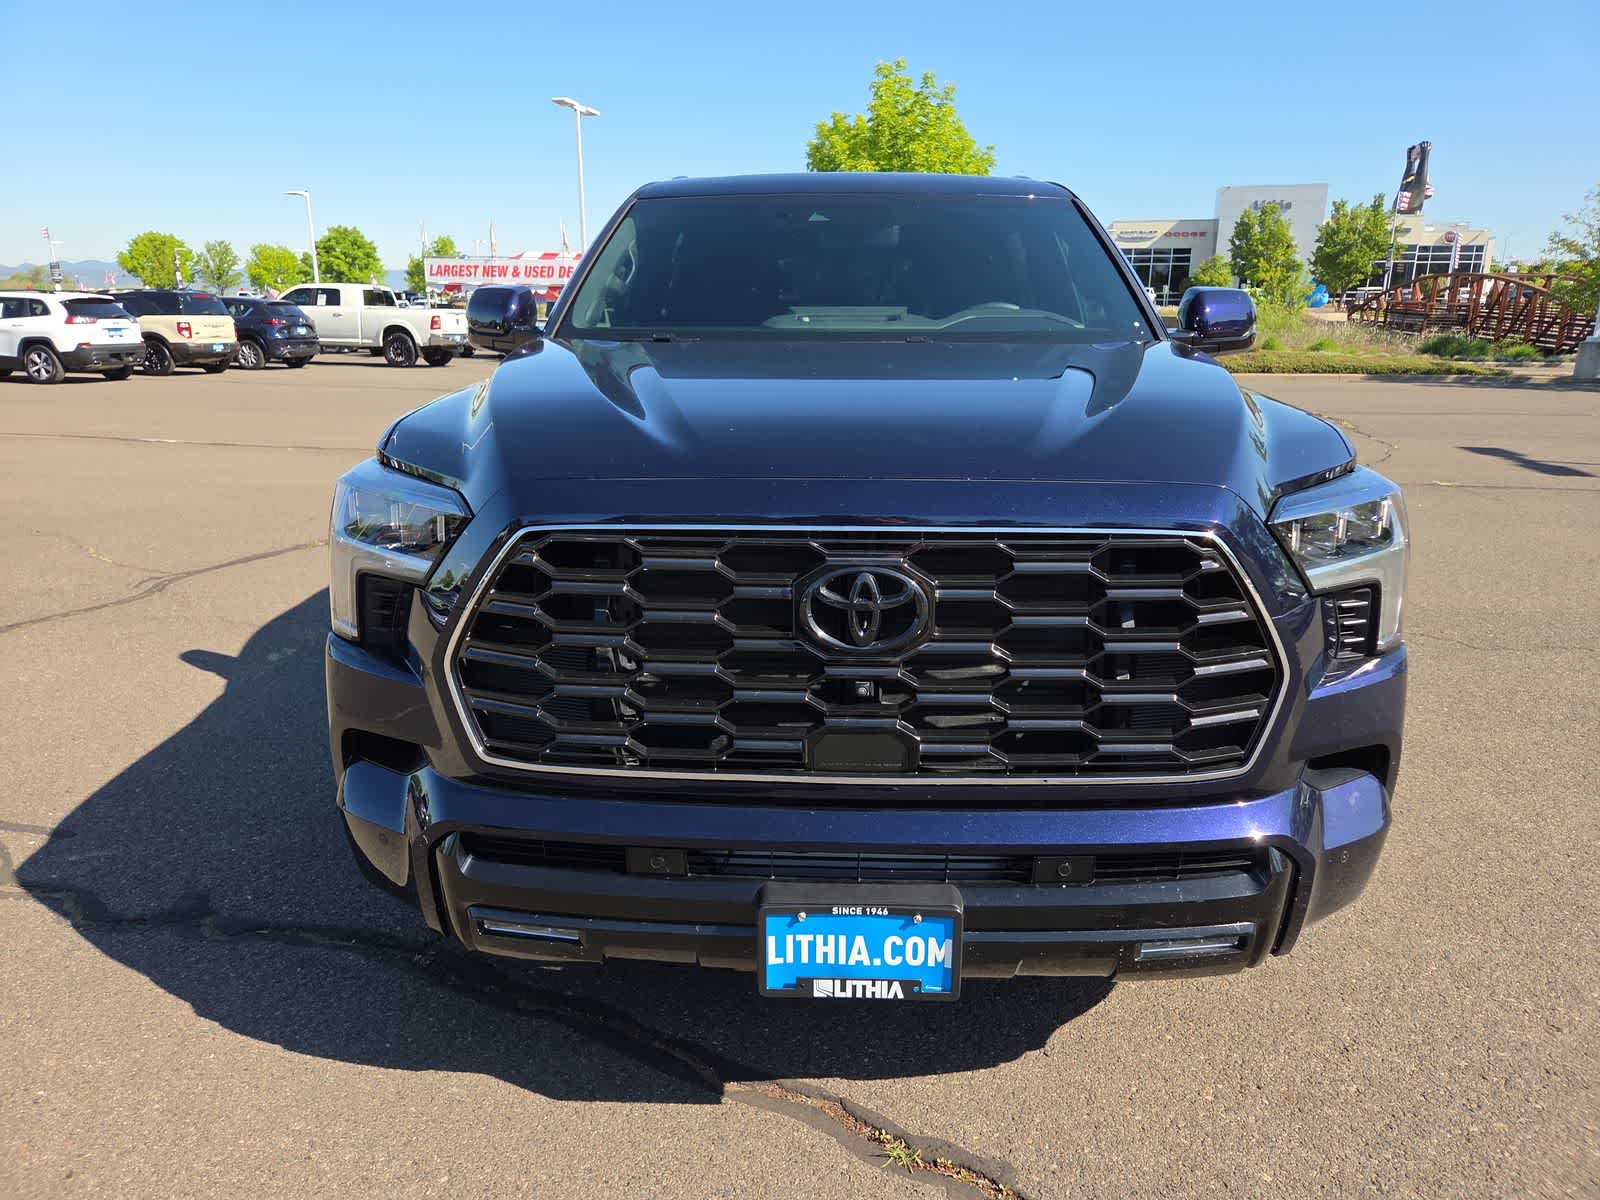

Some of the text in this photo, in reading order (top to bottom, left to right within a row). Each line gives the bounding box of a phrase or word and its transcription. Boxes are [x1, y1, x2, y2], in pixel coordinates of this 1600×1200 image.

[429, 264, 479, 277] LARGEST
[482, 264, 508, 278] NEW
[511, 265, 520, 278] &
[524, 265, 554, 279] USED
[832, 906, 889, 916] SINCE 1946
[767, 934, 953, 969] LITHIA.COM
[834, 979, 904, 999] LITHIA
